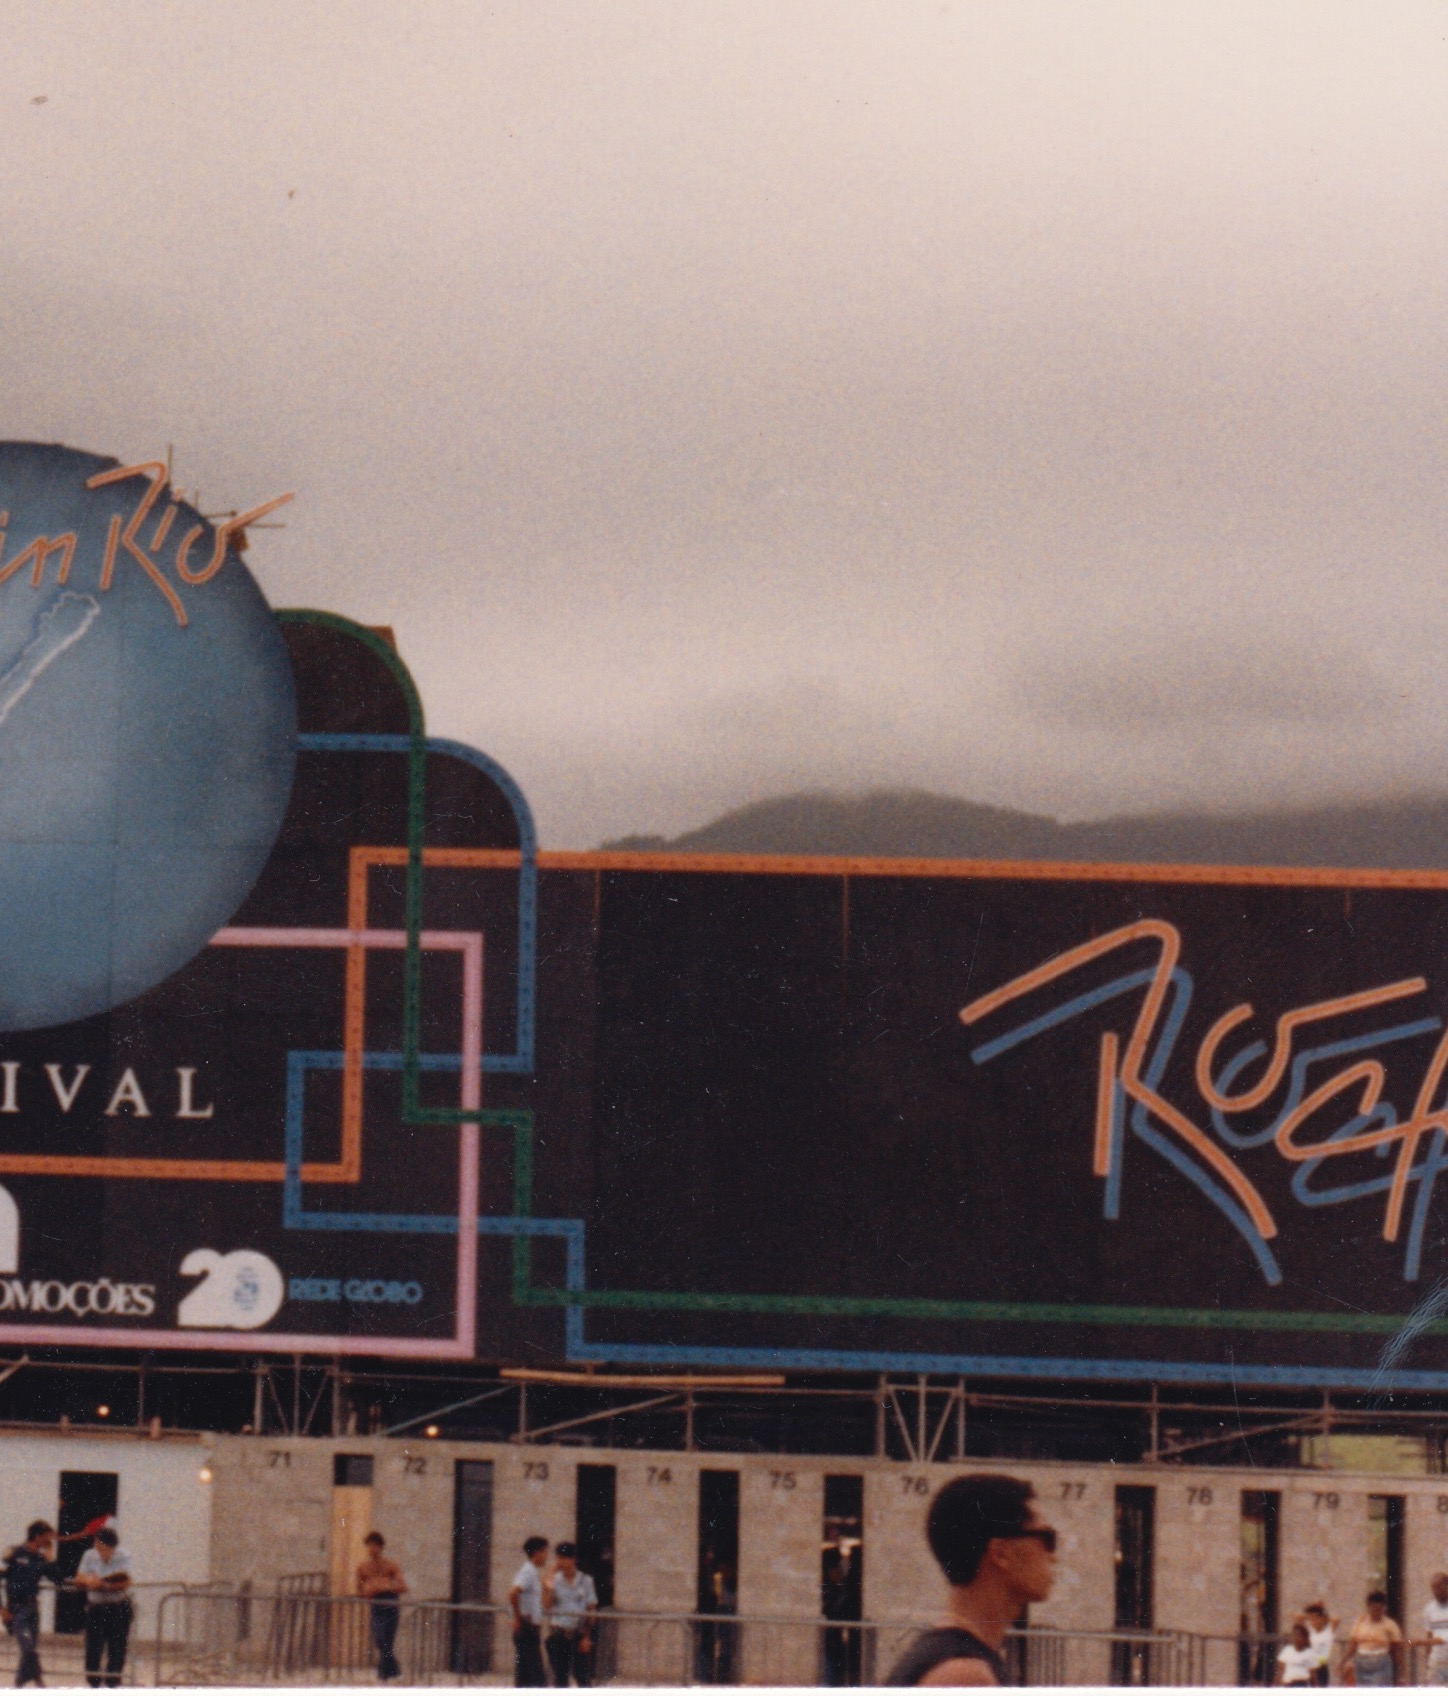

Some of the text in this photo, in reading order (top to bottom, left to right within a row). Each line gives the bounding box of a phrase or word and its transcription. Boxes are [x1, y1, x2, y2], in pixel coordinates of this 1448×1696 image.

[86, 460, 295, 627] Rio
[176, 1247, 285, 1330] 20
[343, 1278, 424, 1305] GLOBO
[269, 1450, 292, 1469] 71
[402, 1456, 426, 1476] 72
[522, 1461, 549, 1481] 73
[645, 1465, 672, 1486] 74
[768, 1470, 797, 1491] 75
[900, 1474, 931, 1497] 76
[1059, 1480, 1086, 1501] 77
[1185, 1485, 1213, 1507] 78
[1311, 1491, 1340, 1512] 79
[1437, 1495, 1448, 1514] 8
